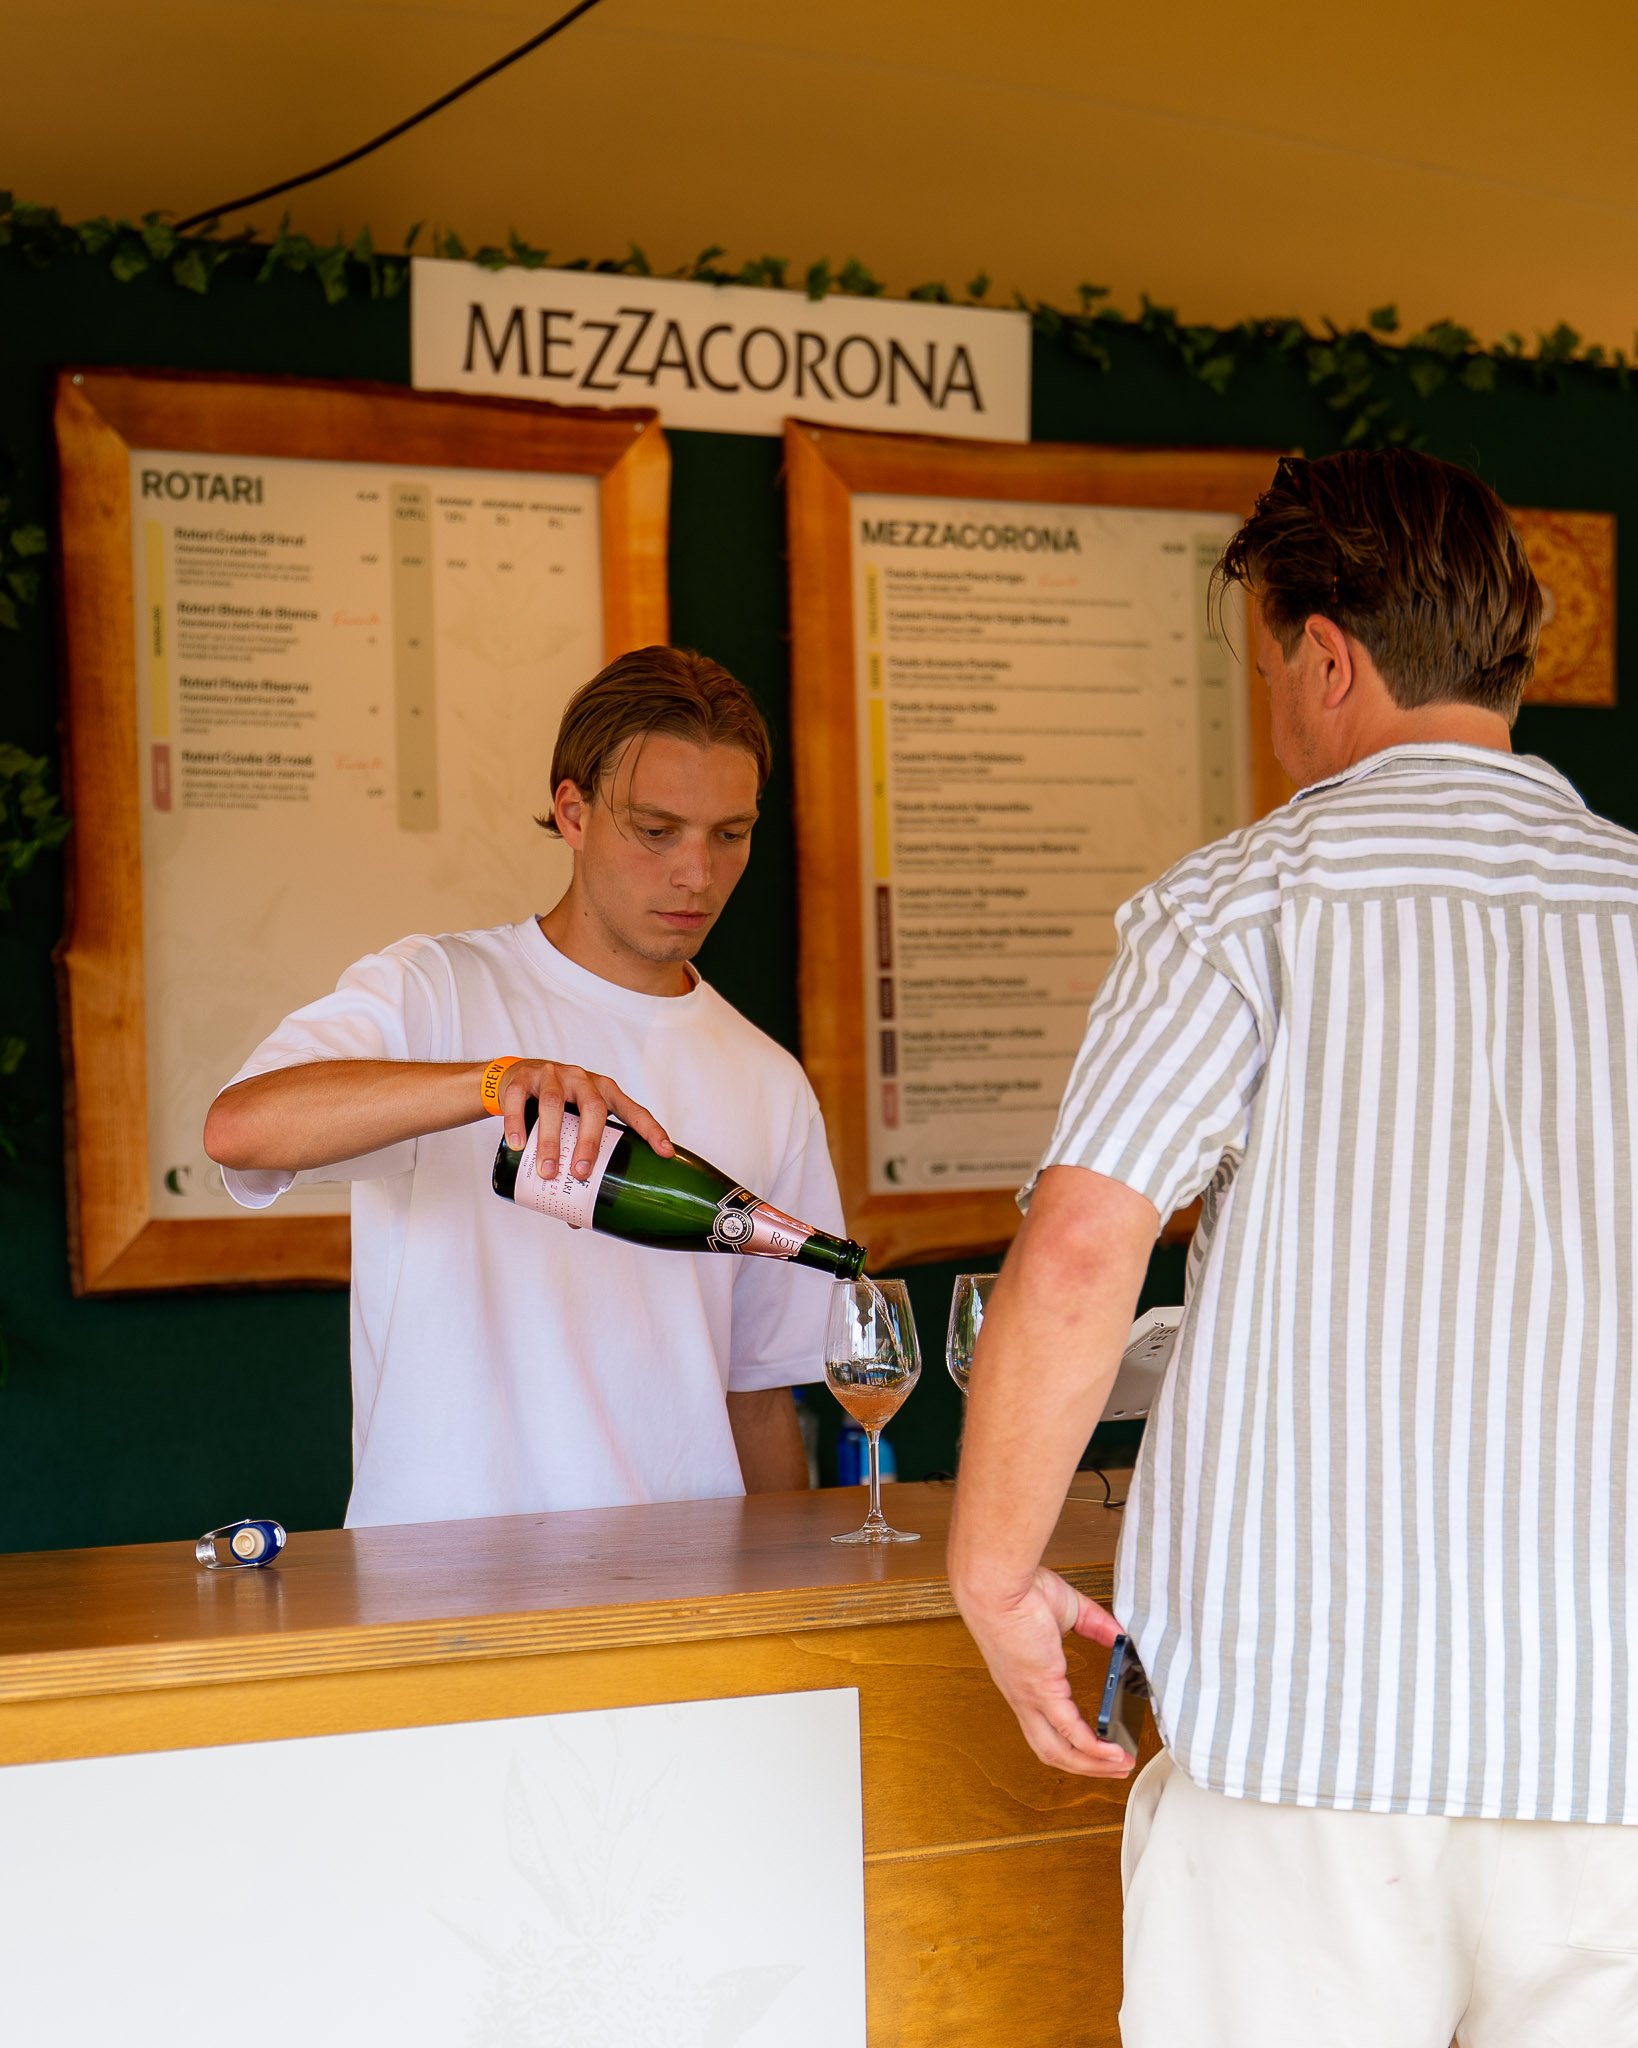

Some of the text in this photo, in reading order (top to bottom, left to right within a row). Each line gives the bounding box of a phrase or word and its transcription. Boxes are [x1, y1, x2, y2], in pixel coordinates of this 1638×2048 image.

[462, 302, 986, 413] MEZZACORONA
[141, 469, 264, 506] ROTARI
[861, 518, 1082, 555] MEZZACORONA
[485, 1064, 504, 1099] CREW
[562, 1173, 575, 1195] TARI
